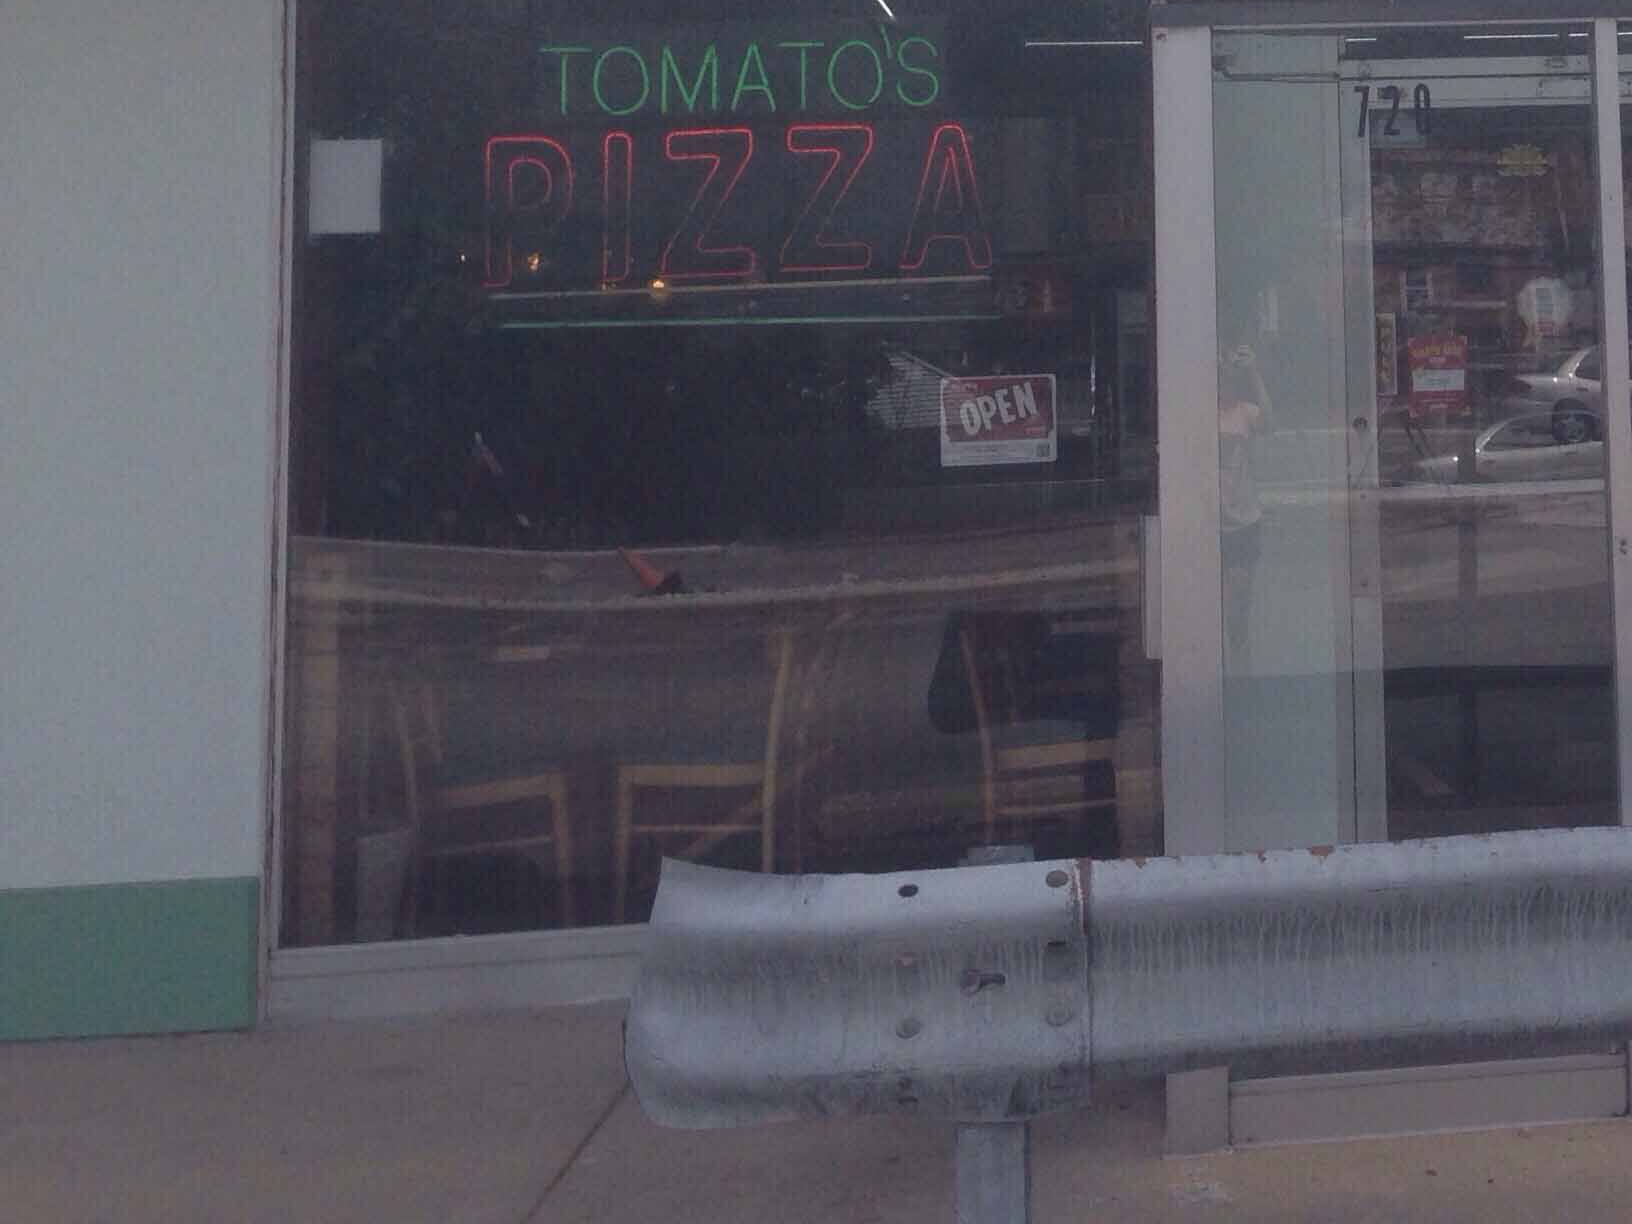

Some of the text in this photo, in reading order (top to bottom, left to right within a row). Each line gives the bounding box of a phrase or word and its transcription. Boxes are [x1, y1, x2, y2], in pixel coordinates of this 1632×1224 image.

[538, 23, 941, 116] TOMATO'S
[1353, 82, 1433, 138] 720
[483, 123, 993, 288] PIZZA
[959, 380, 1040, 437] OPEN
